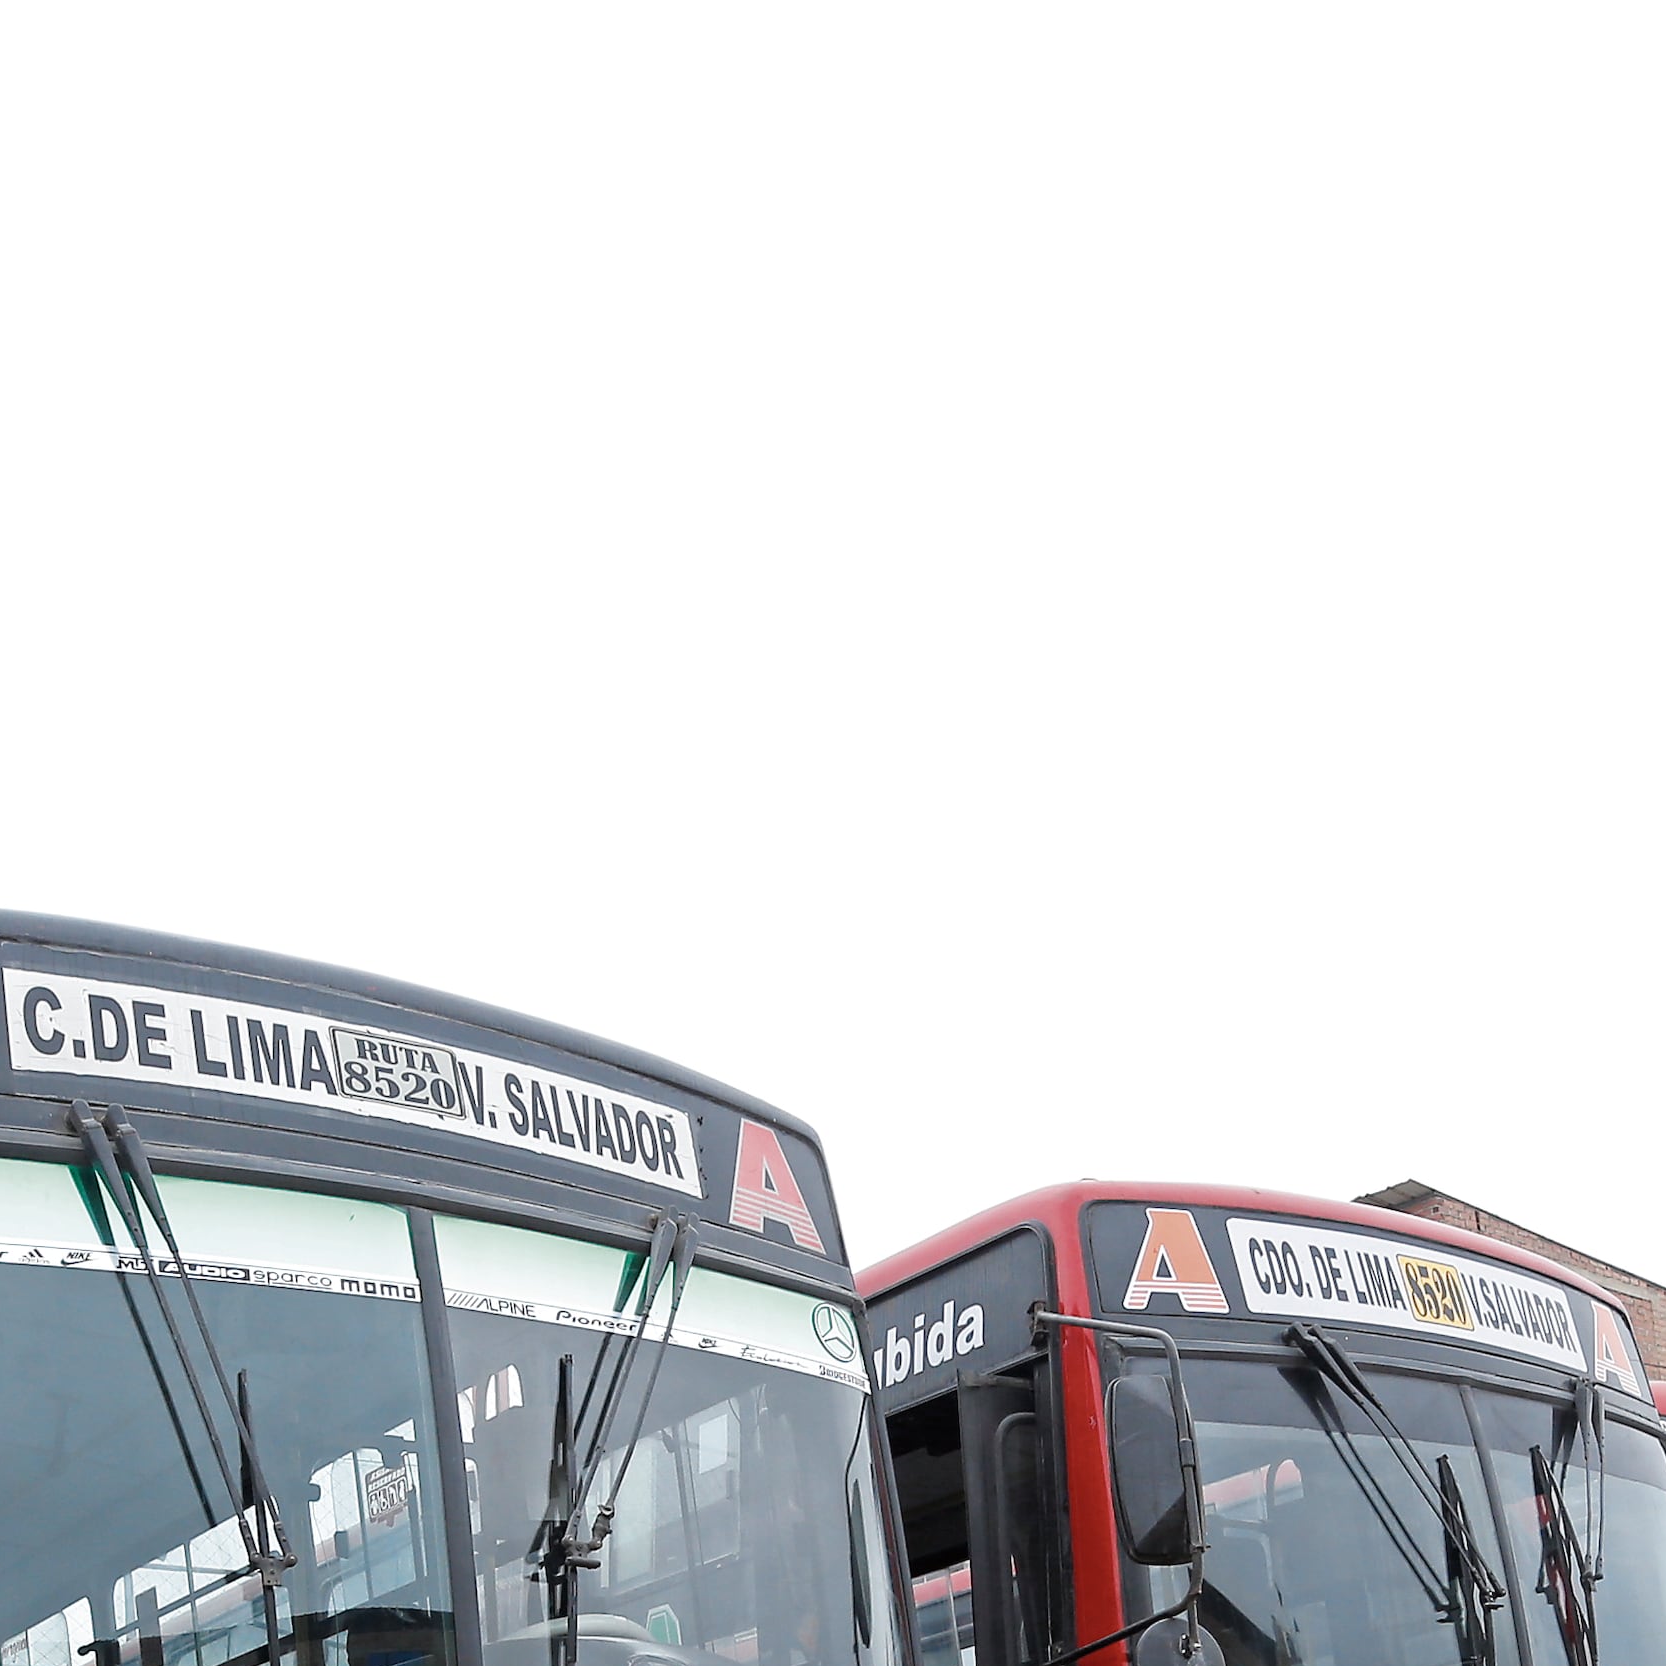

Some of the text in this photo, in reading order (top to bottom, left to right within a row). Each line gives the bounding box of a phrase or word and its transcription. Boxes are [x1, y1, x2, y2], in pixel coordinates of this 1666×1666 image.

[190, 1009, 338, 1096] LIMA
[504, 1072, 684, 1180] SALVADOR
[343, 1061, 456, 1110] 8520
[354, 1037, 440, 1074] RUTA
[729, 1118, 828, 1256] A
[162, 1260, 249, 1281] AUDIO
[254, 1269, 332, 1287] sparco
[341, 1278, 417, 1299] momo
[1123, 1207, 1230, 1313] A
[1249, 1237, 1311, 1298] CDO.
[1308, 1244, 1349, 1302] DE
[1344, 1249, 1408, 1312] LIMA
[1404, 1262, 1466, 1326] 8520
[476, 1298, 537, 1318] ALPINE
[556, 1310, 637, 1332] Pioneer
[1591, 1299, 1642, 1398] A
